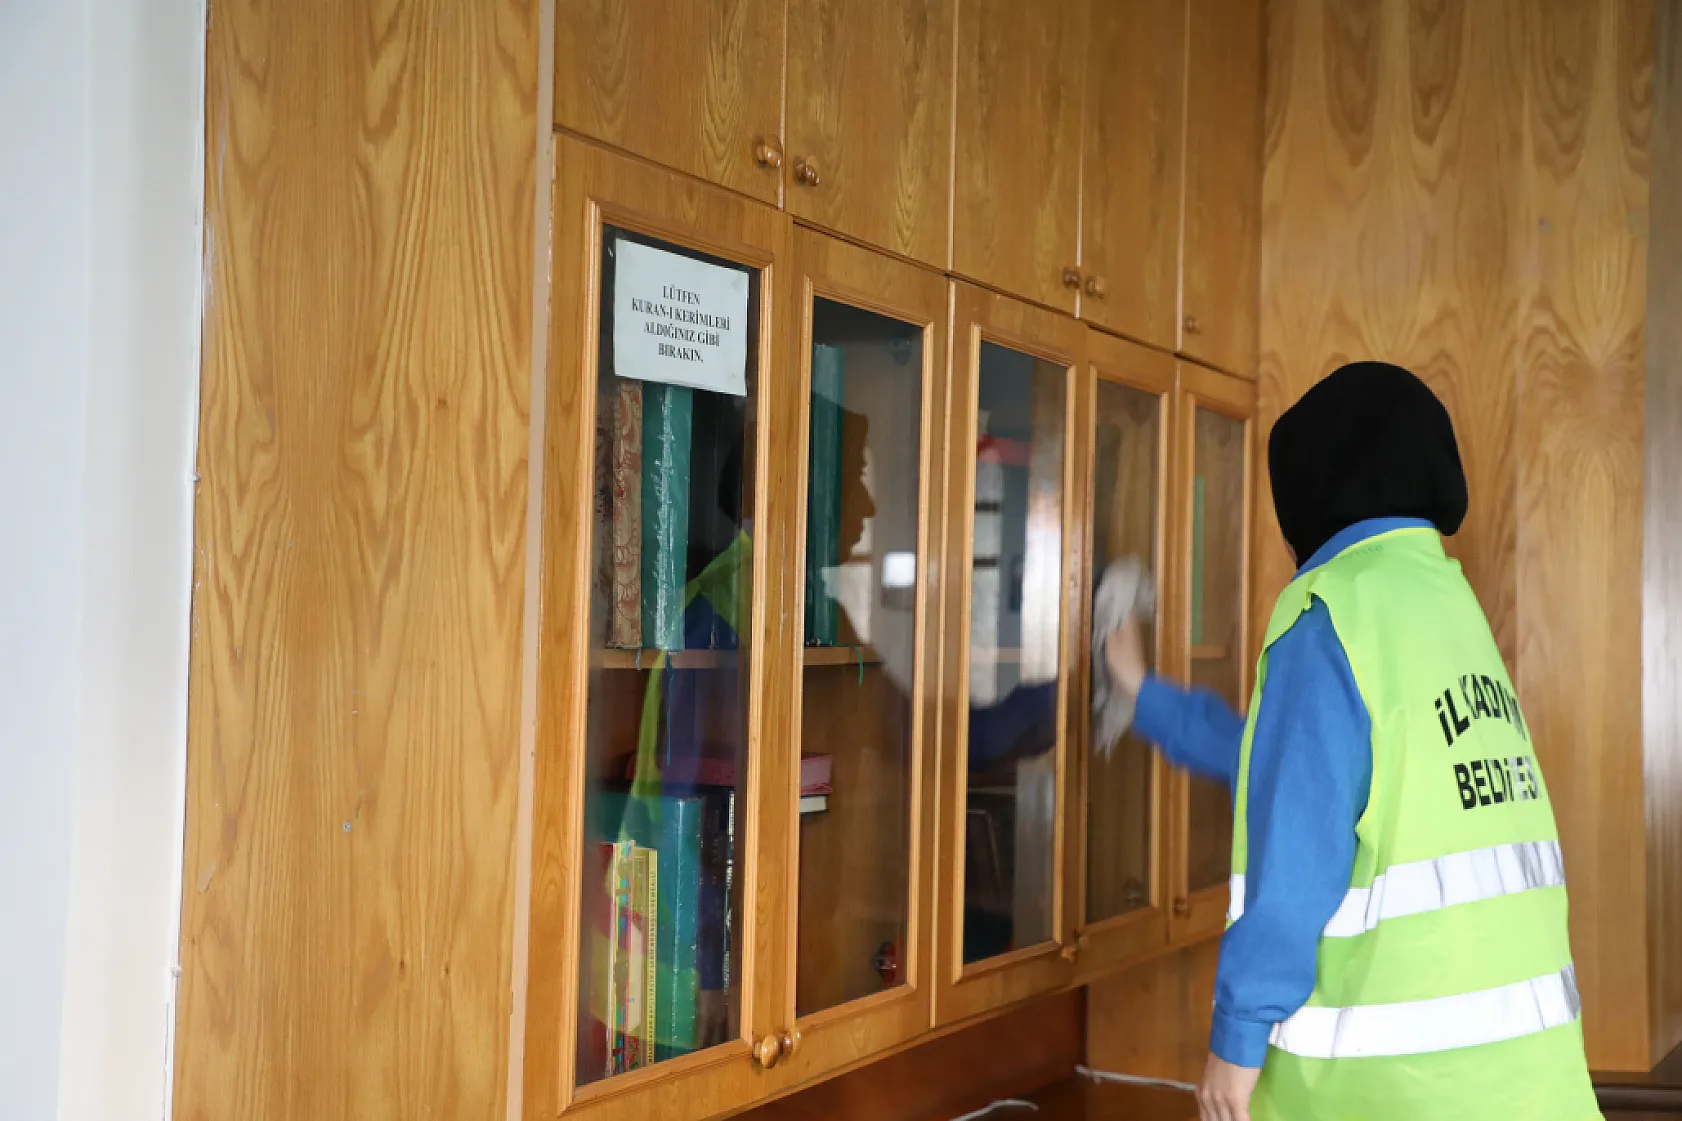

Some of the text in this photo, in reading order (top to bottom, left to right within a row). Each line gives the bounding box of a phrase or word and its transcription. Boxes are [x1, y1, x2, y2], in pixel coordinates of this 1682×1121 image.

[663, 285, 700, 305] LÜTFEN
[632, 297, 730, 331] KURAN-I KERİMLERİ
[644, 321, 720, 347] ALDIĞINIZ GİBİ
